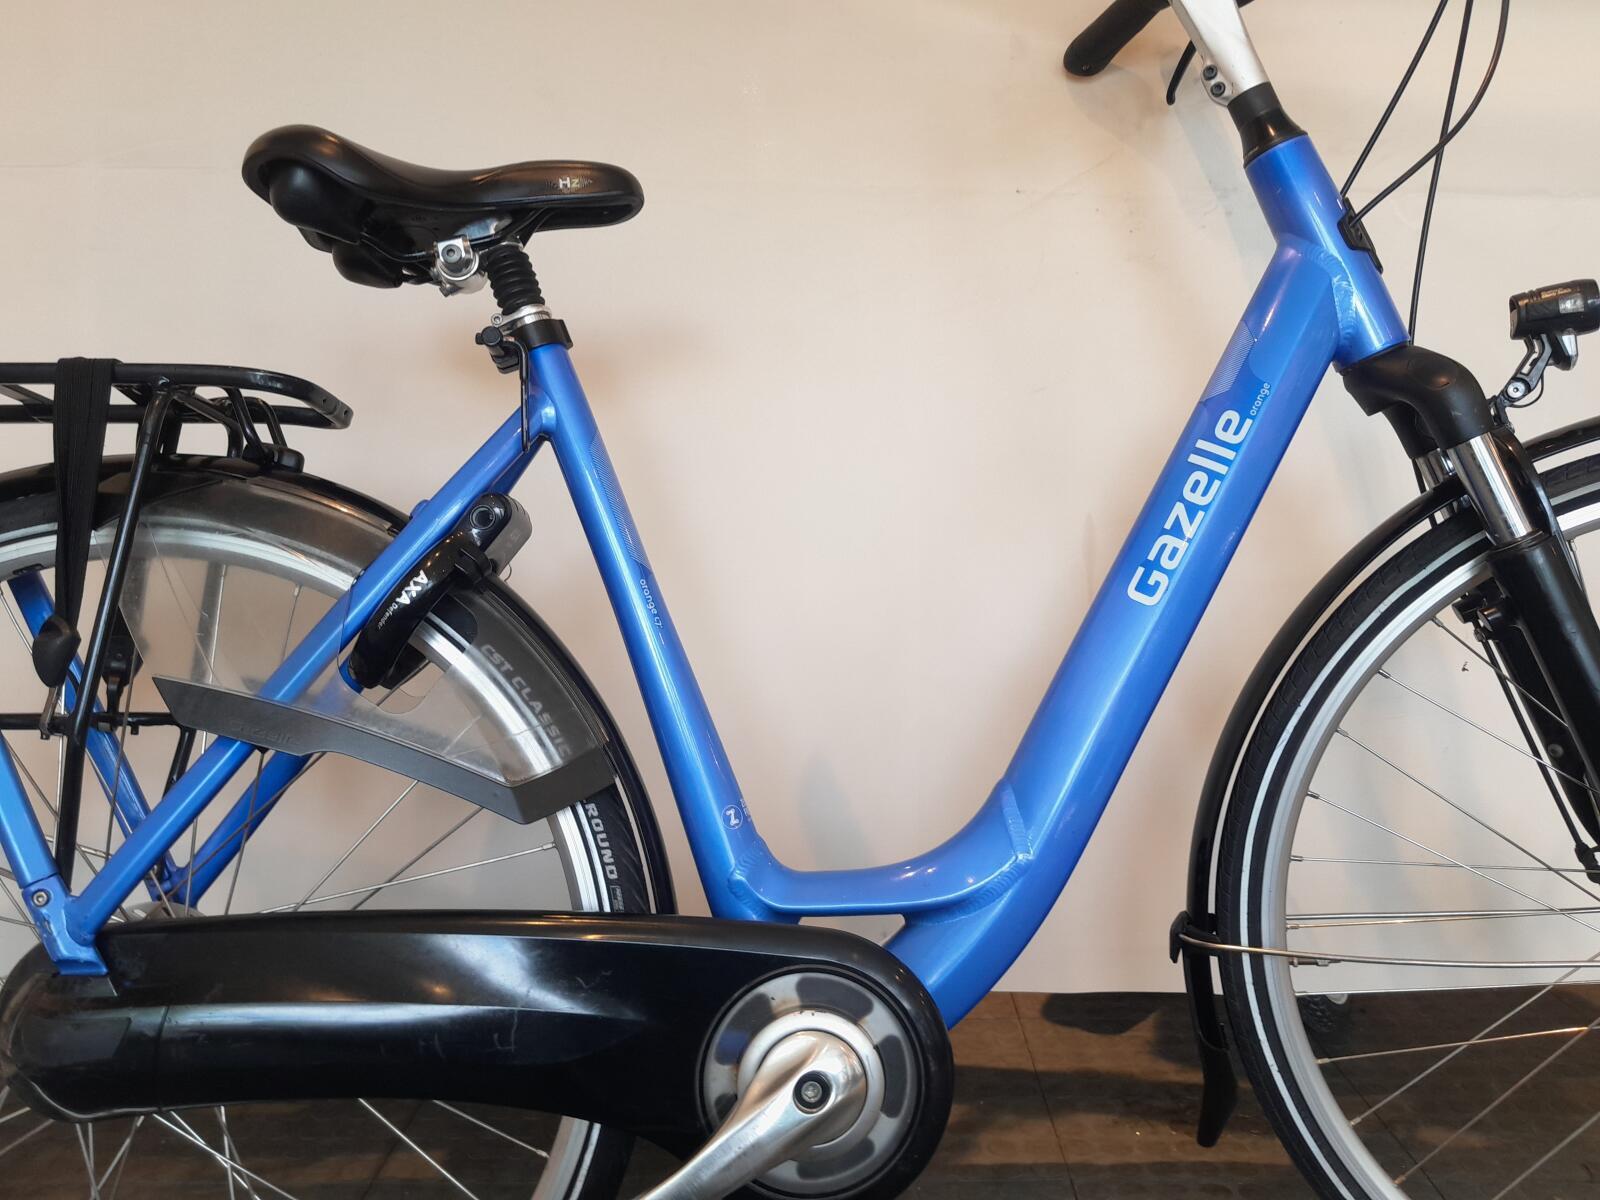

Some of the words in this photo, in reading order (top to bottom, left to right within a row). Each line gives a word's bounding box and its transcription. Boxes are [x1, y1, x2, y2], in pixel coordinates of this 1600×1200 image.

[1250, 382, 1270, 416] orange
[1127, 409, 1253, 606] Gazelle
[396, 569, 429, 605] AXA
[639, 578, 658, 615] orange
[377, 602, 398, 630] Defender
[480, 643, 514, 672] CST
[511, 676, 573, 758] CLASSIC
[583, 799, 619, 880] ROUND
